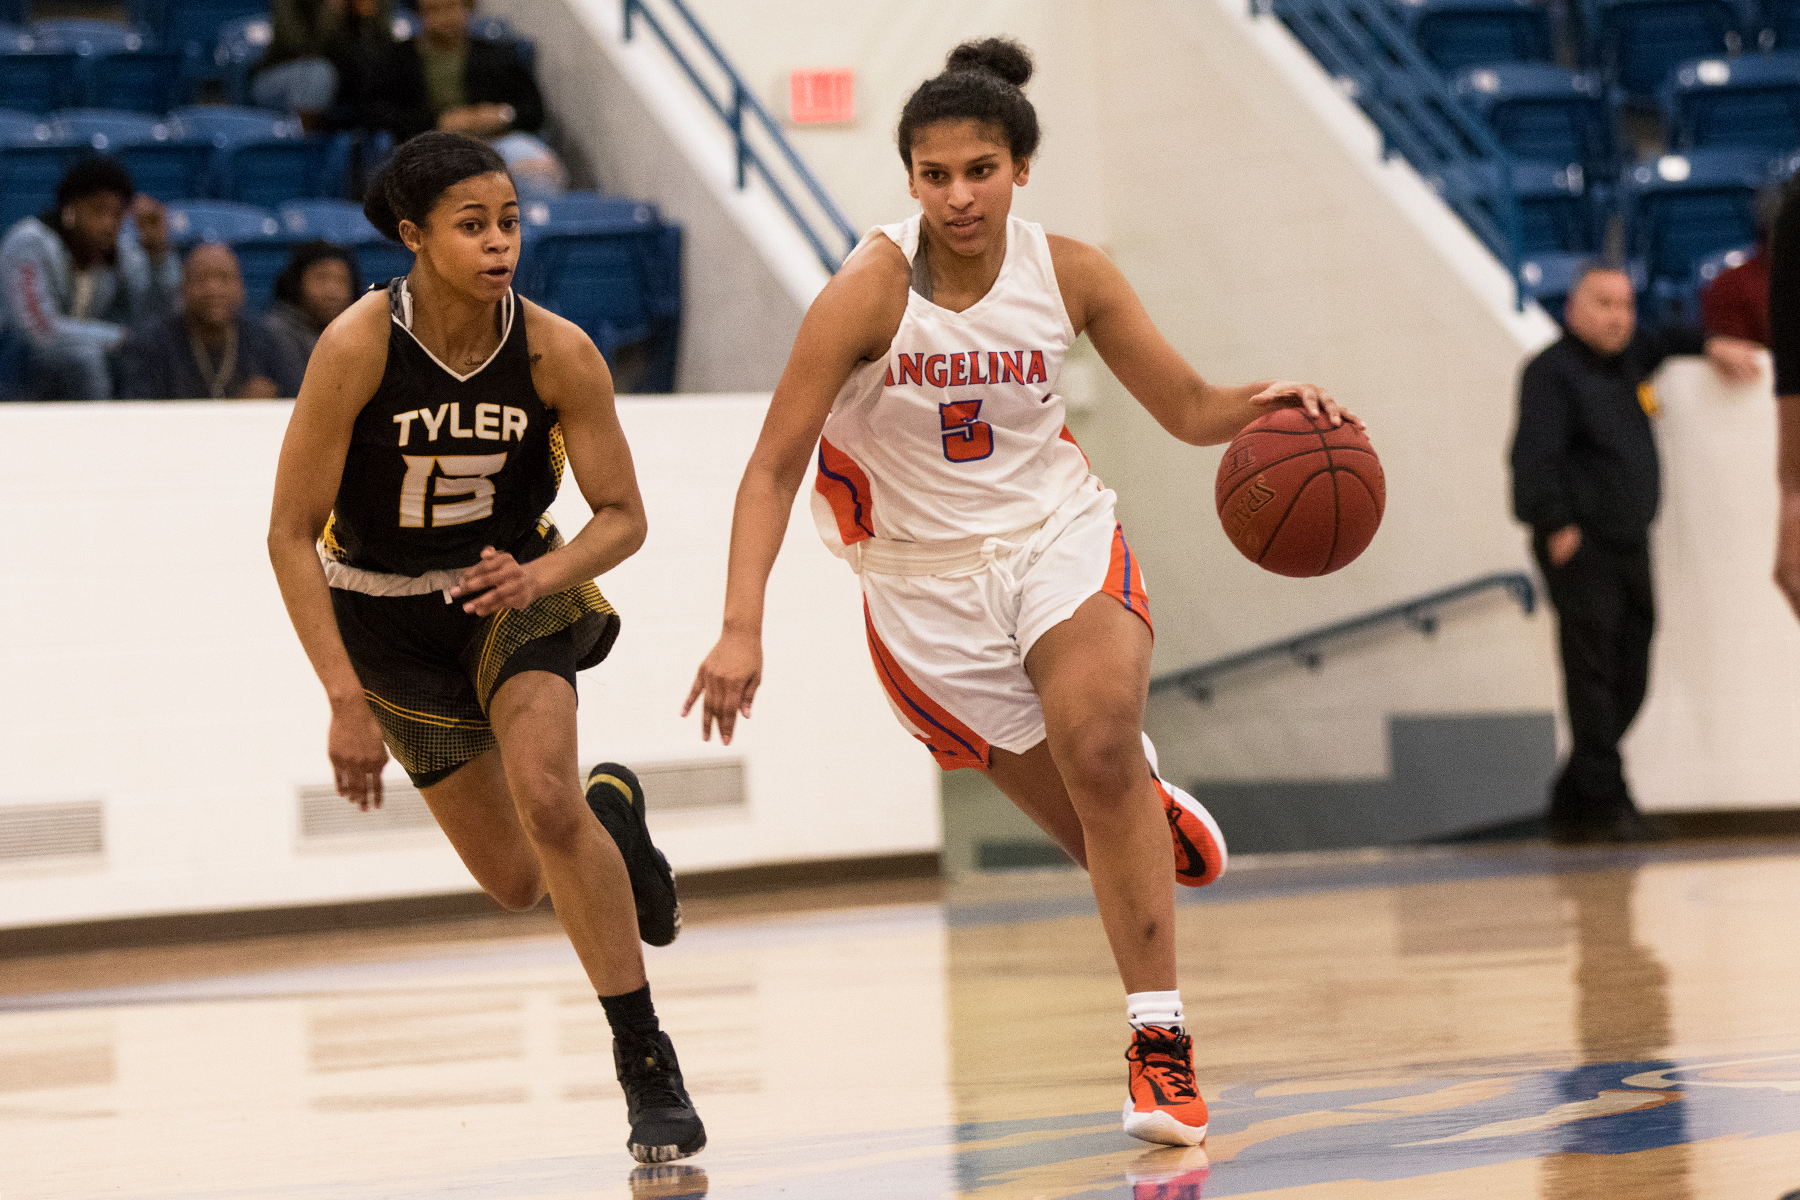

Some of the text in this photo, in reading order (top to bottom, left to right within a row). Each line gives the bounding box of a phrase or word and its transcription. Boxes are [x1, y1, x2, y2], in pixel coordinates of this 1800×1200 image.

[393, 402, 528, 446] TYLER
[939, 399, 995, 463] 5
[399, 451, 508, 528] 13
